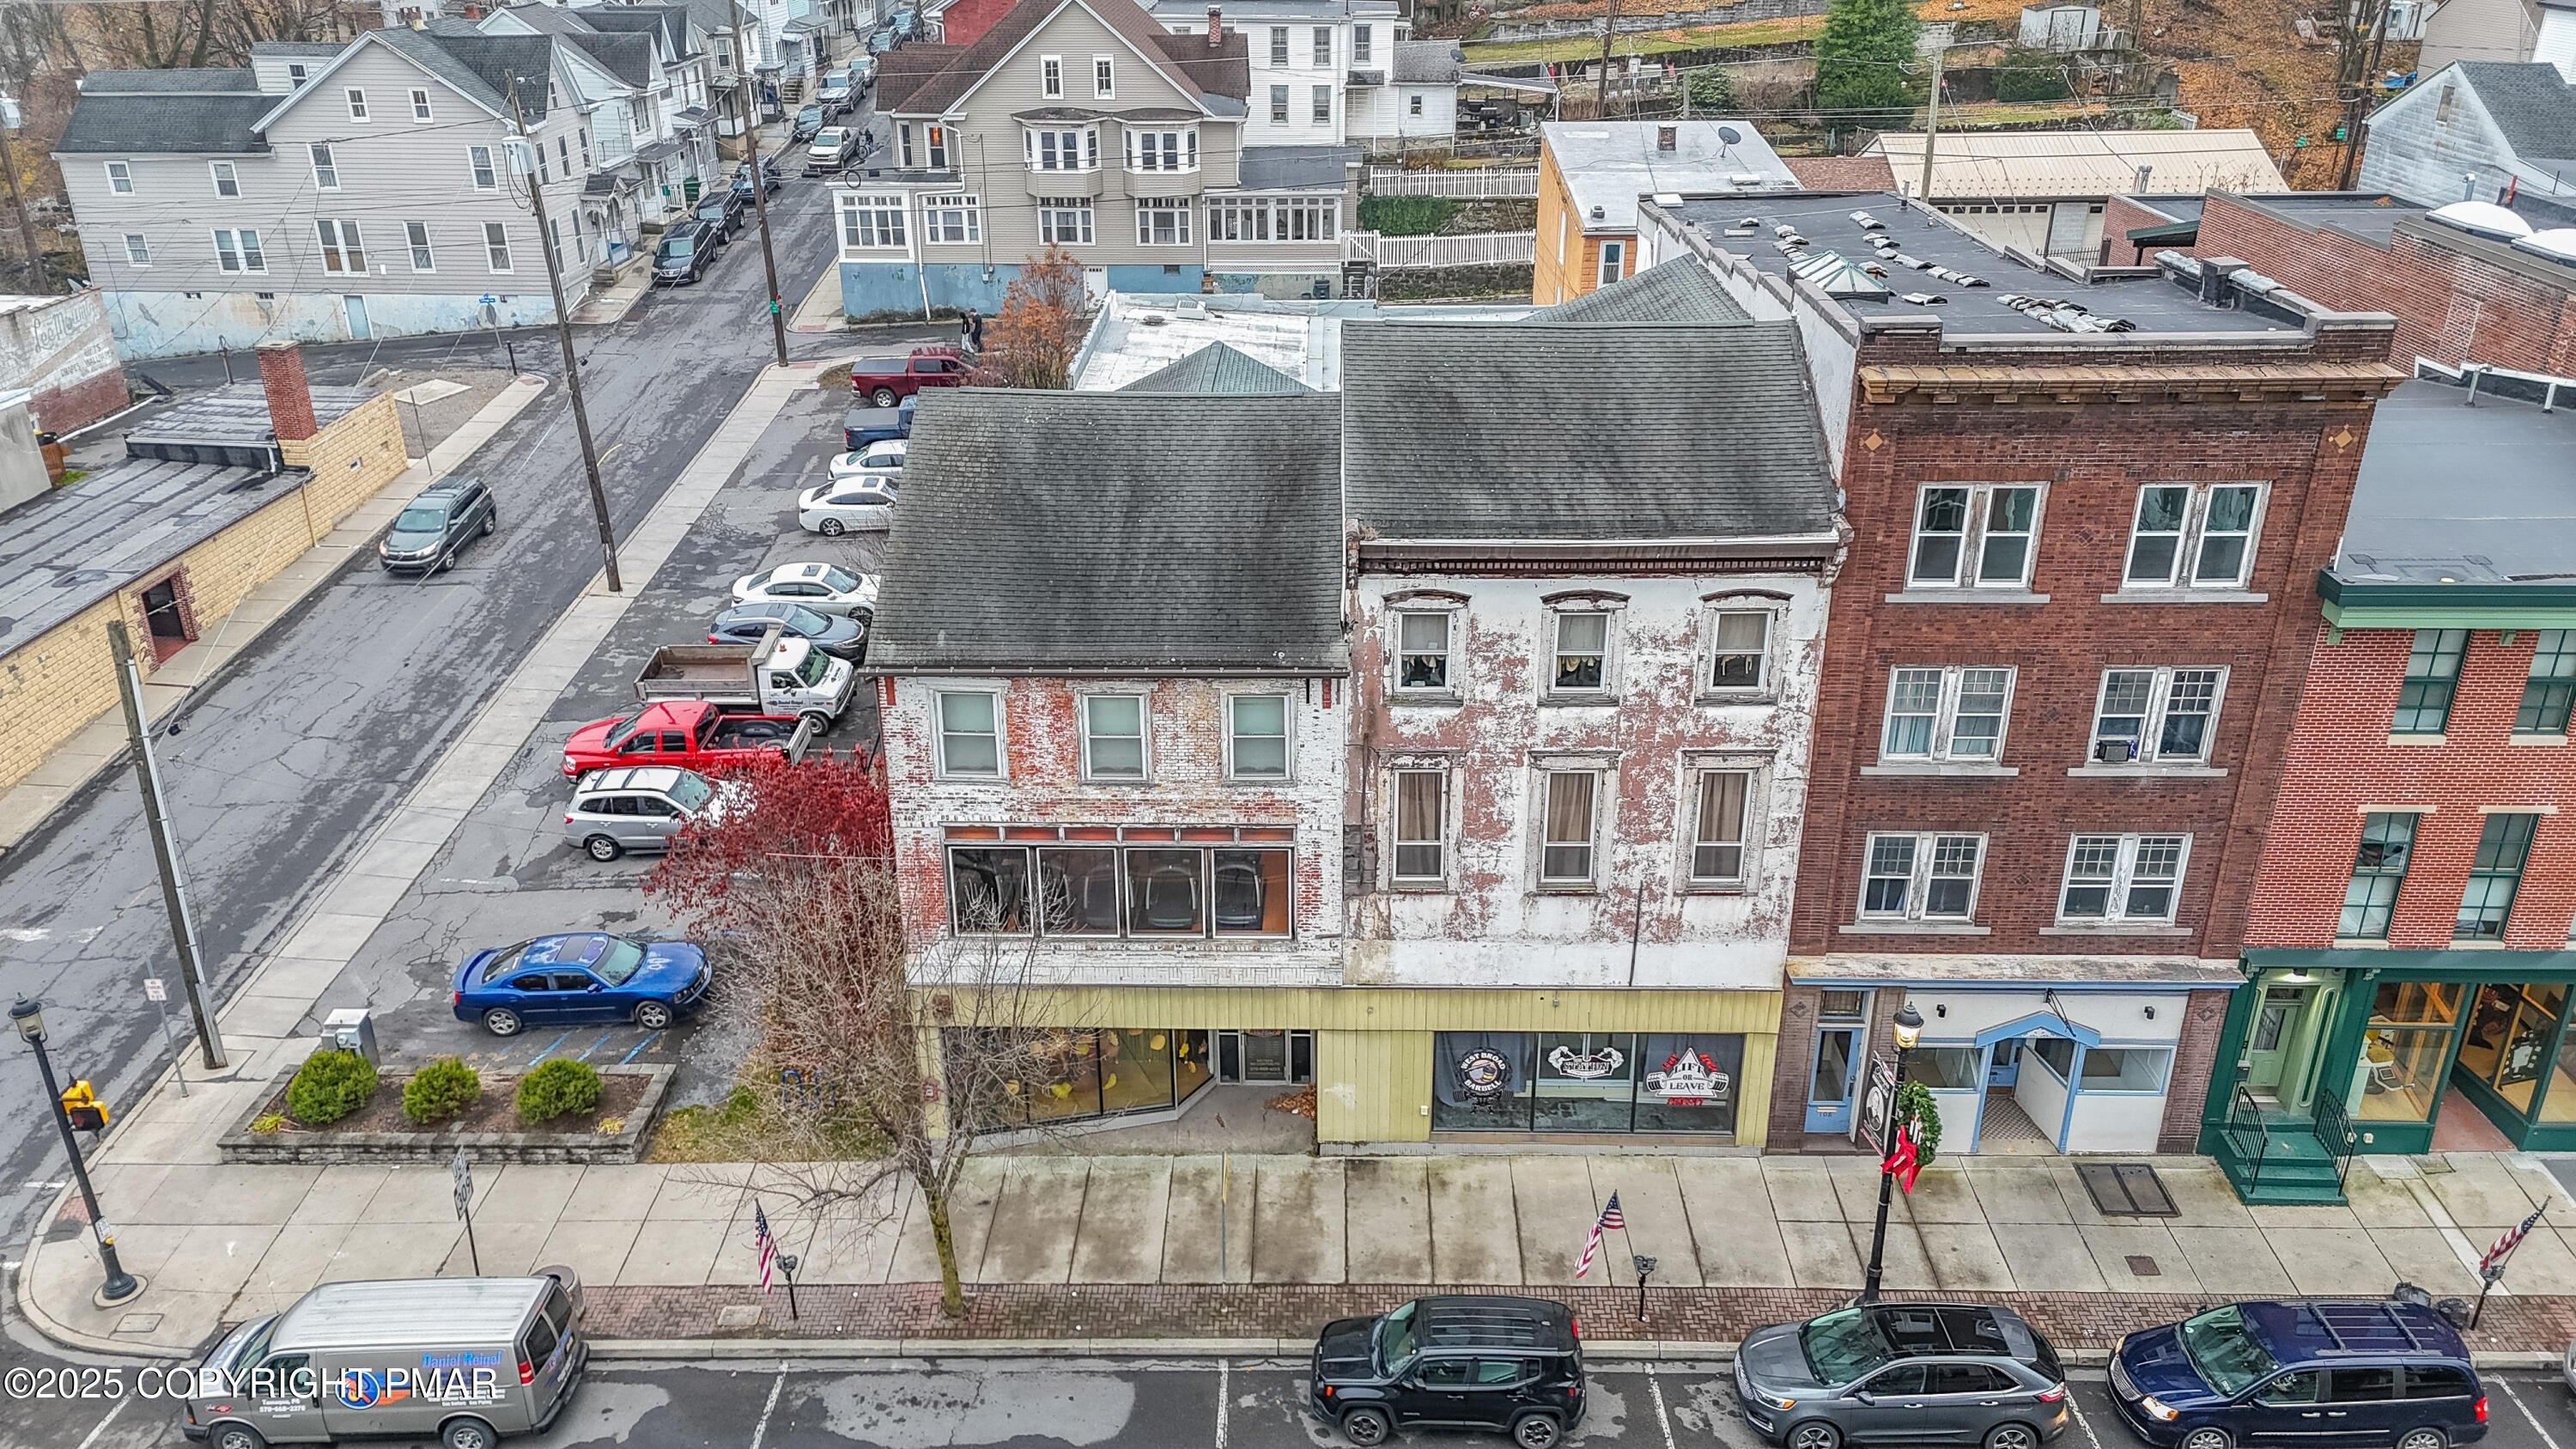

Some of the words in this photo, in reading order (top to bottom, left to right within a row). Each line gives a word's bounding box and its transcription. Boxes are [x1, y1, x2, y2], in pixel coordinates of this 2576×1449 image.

[1461, 1053, 1479, 1069] WEST
[1480, 1052, 1506, 1070] BROAD
[1563, 1062, 1610, 1071] STATION
[1674, 1062, 1704, 1074] LIFT
[1464, 1079, 1503, 1092] BARBELL
[456, 1174, 471, 1211] 309
[422, 1352, 460, 1368] Daniel
